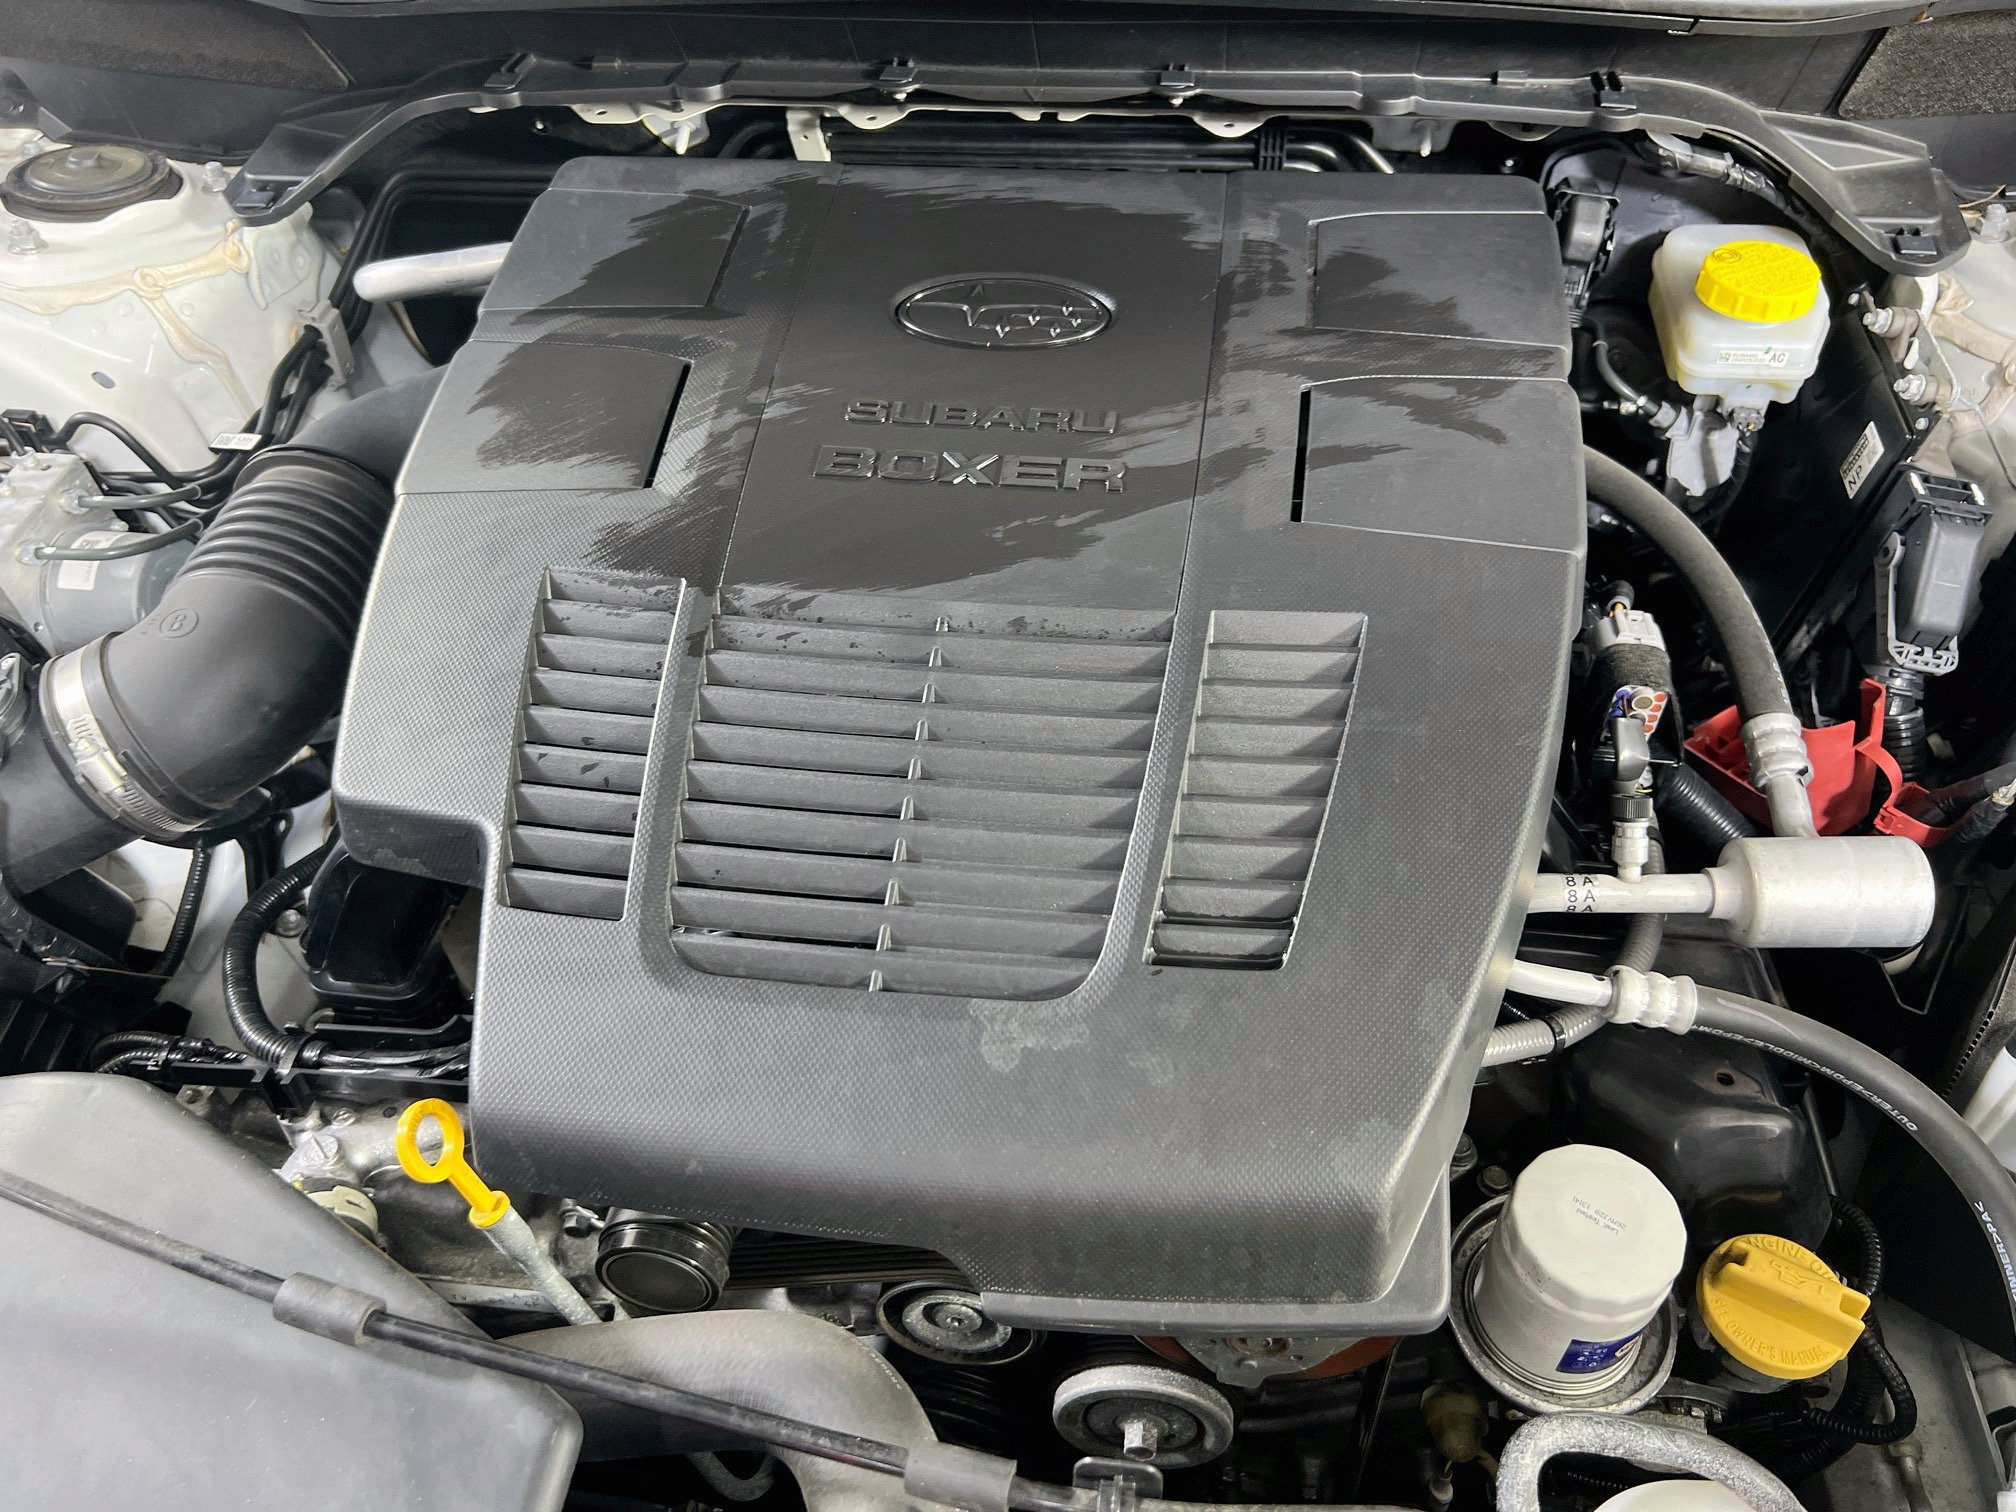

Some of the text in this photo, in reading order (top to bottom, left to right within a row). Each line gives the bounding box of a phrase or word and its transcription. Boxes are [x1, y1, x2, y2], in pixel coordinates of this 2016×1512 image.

[1769, 352, 1786, 364] AC
[844, 400, 1118, 434] SUBARU
[812, 445, 1127, 493] BOXER
[1742, 1236, 1807, 1260] NGINE
